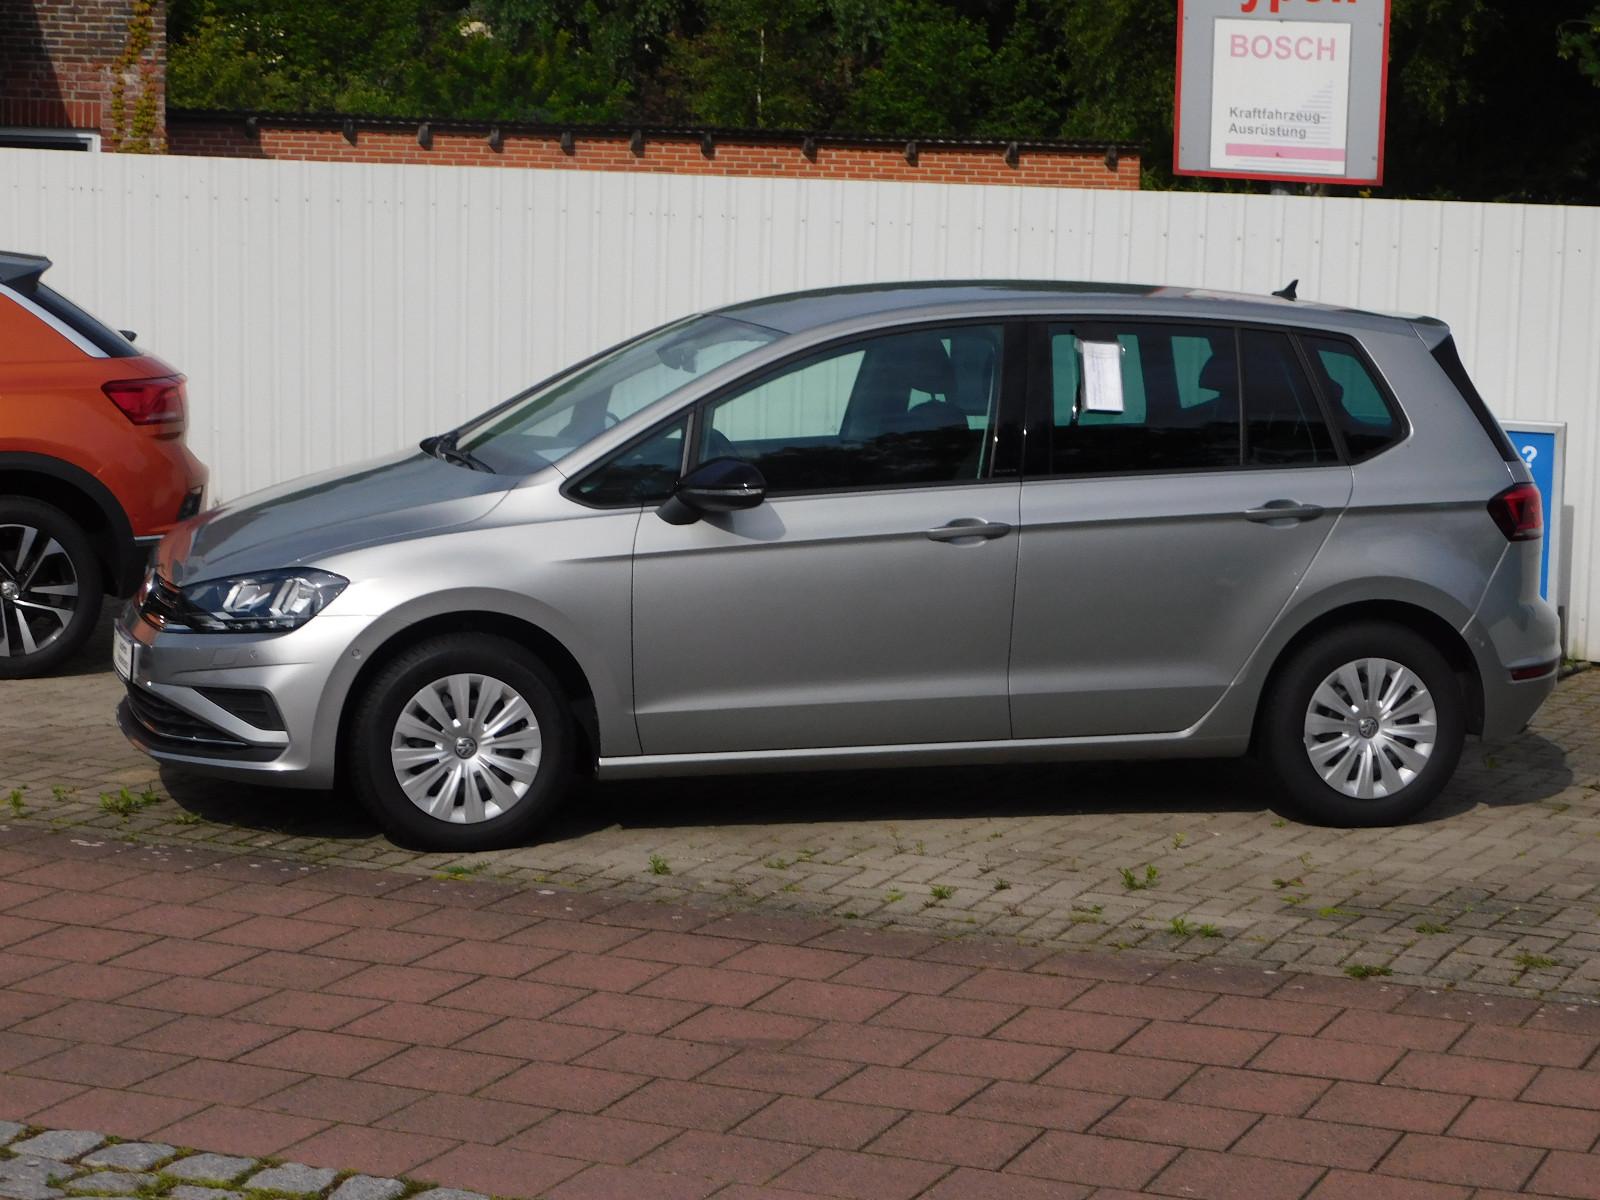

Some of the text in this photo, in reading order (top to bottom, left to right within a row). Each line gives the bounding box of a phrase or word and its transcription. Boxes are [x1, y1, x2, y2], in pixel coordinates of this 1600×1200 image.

[1230, 34, 1336, 61] BOSCH
[1229, 106, 1327, 124] Kraftfahrzeug-
[1228, 122, 1306, 139] Ausrüstung
